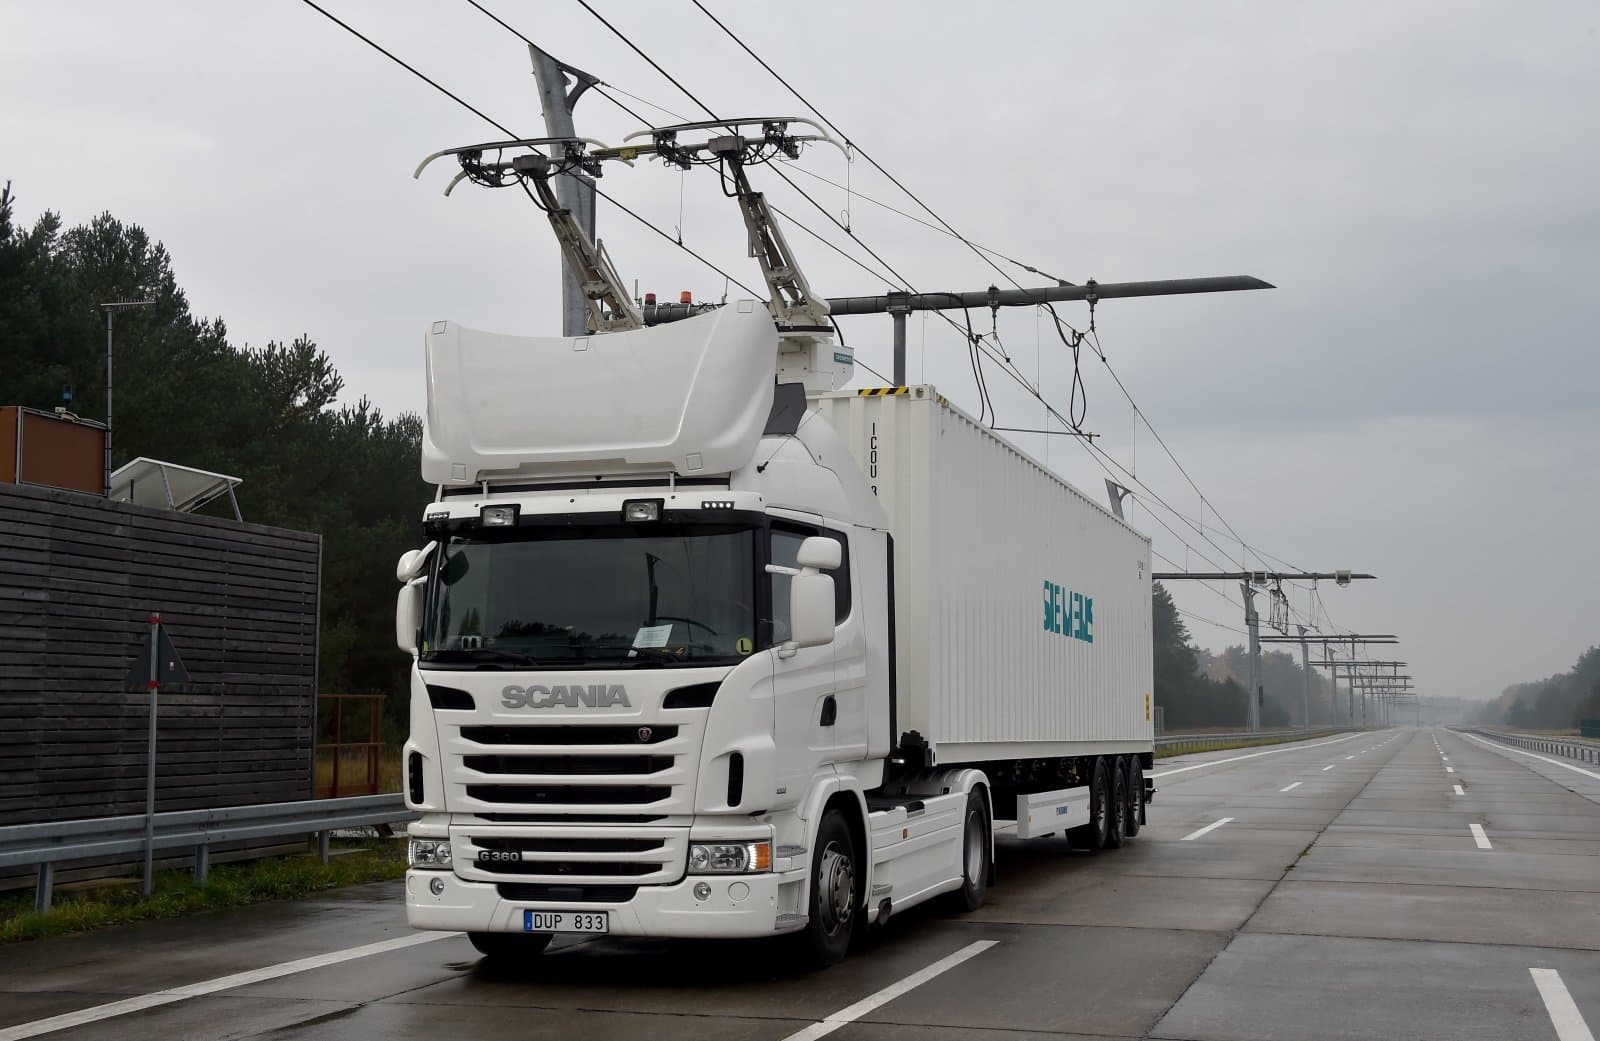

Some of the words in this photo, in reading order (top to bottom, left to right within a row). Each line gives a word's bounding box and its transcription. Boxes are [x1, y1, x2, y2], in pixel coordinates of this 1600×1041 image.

[740, 639, 750, 652] L
[501, 684, 632, 709] SCANIA
[534, 913, 562, 929] DUP
[574, 915, 603, 930] 833
